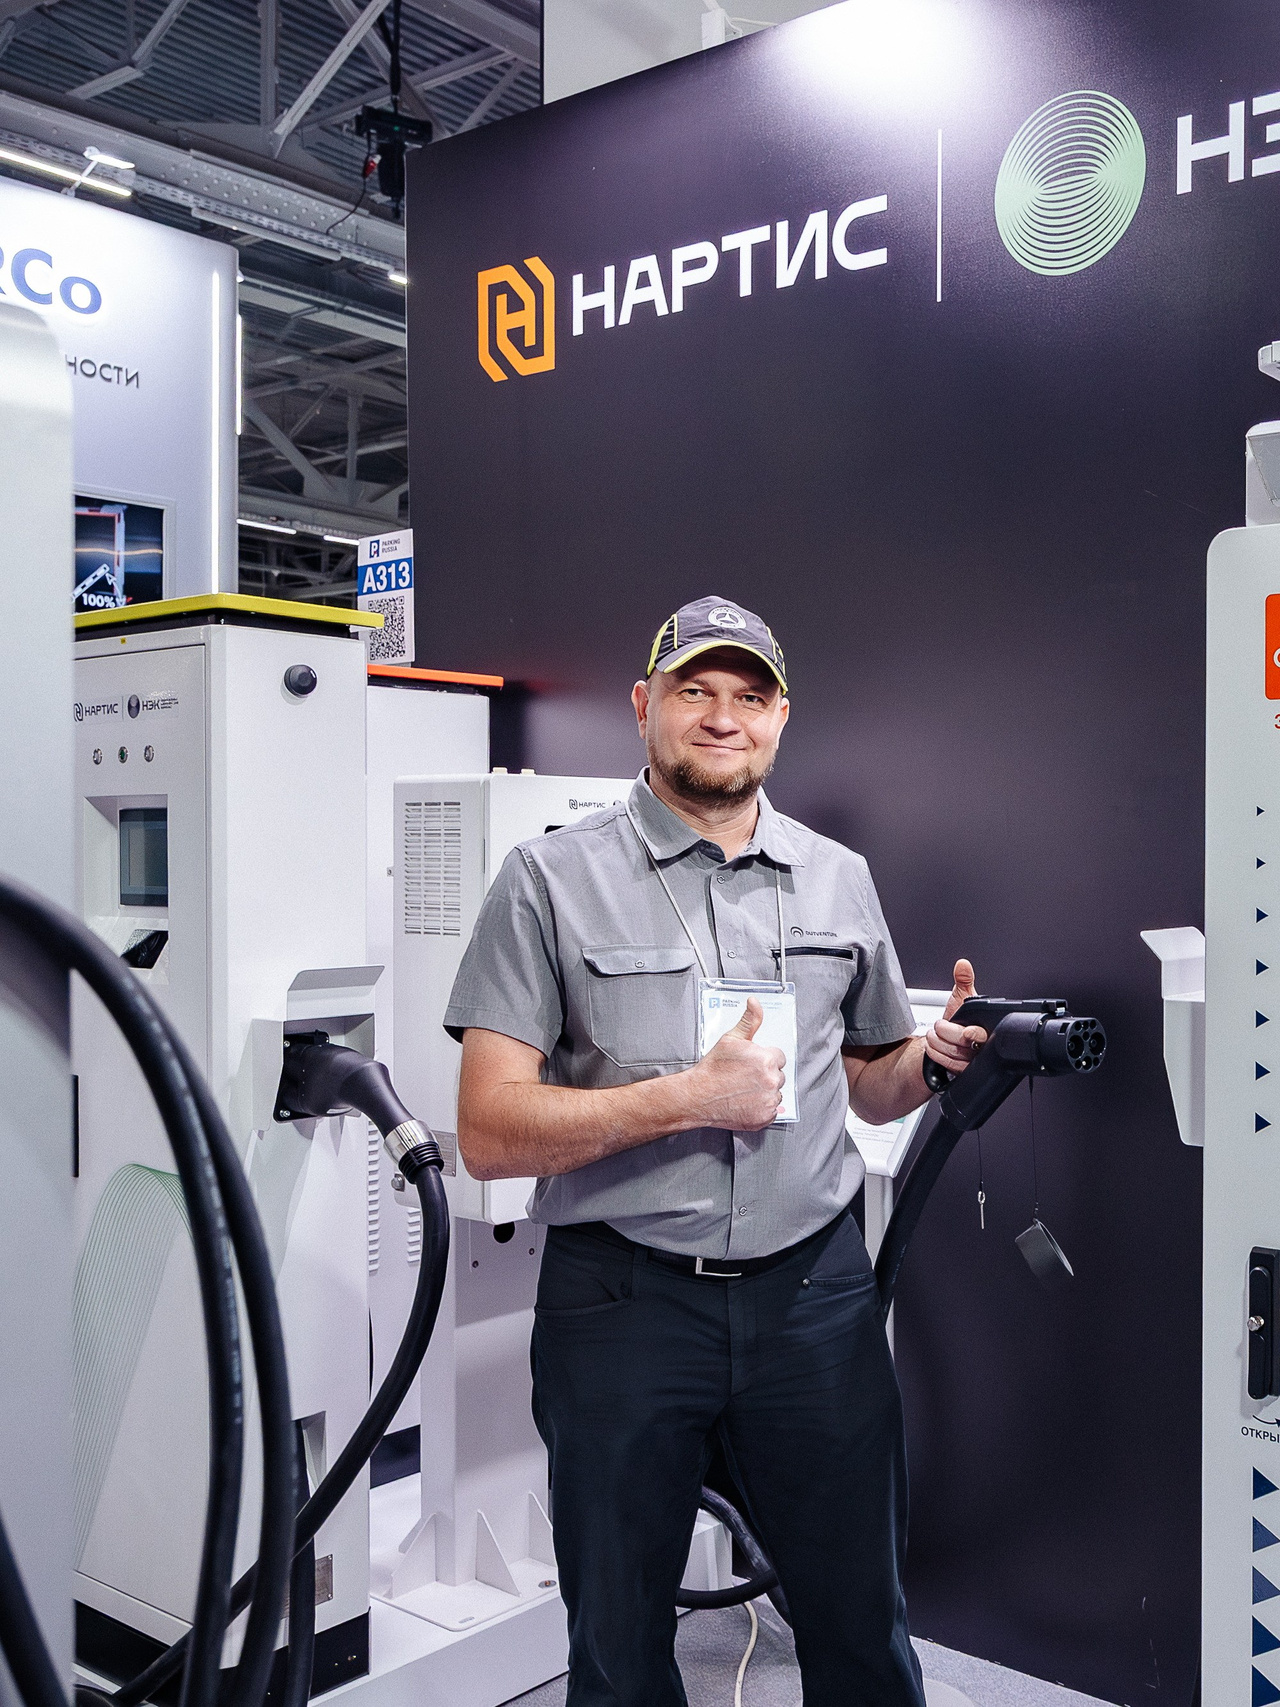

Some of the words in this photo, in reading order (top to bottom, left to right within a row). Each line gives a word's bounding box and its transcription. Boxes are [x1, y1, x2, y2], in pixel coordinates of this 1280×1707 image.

[0, 247, 102, 314] Co
[572, 194, 887, 336] НАРТИС
[363, 562, 410, 593] A313
[82, 593, 115, 608] 100%
[85, 703, 118, 716] НАРТИС
[142, 700, 160, 711] НЭК
